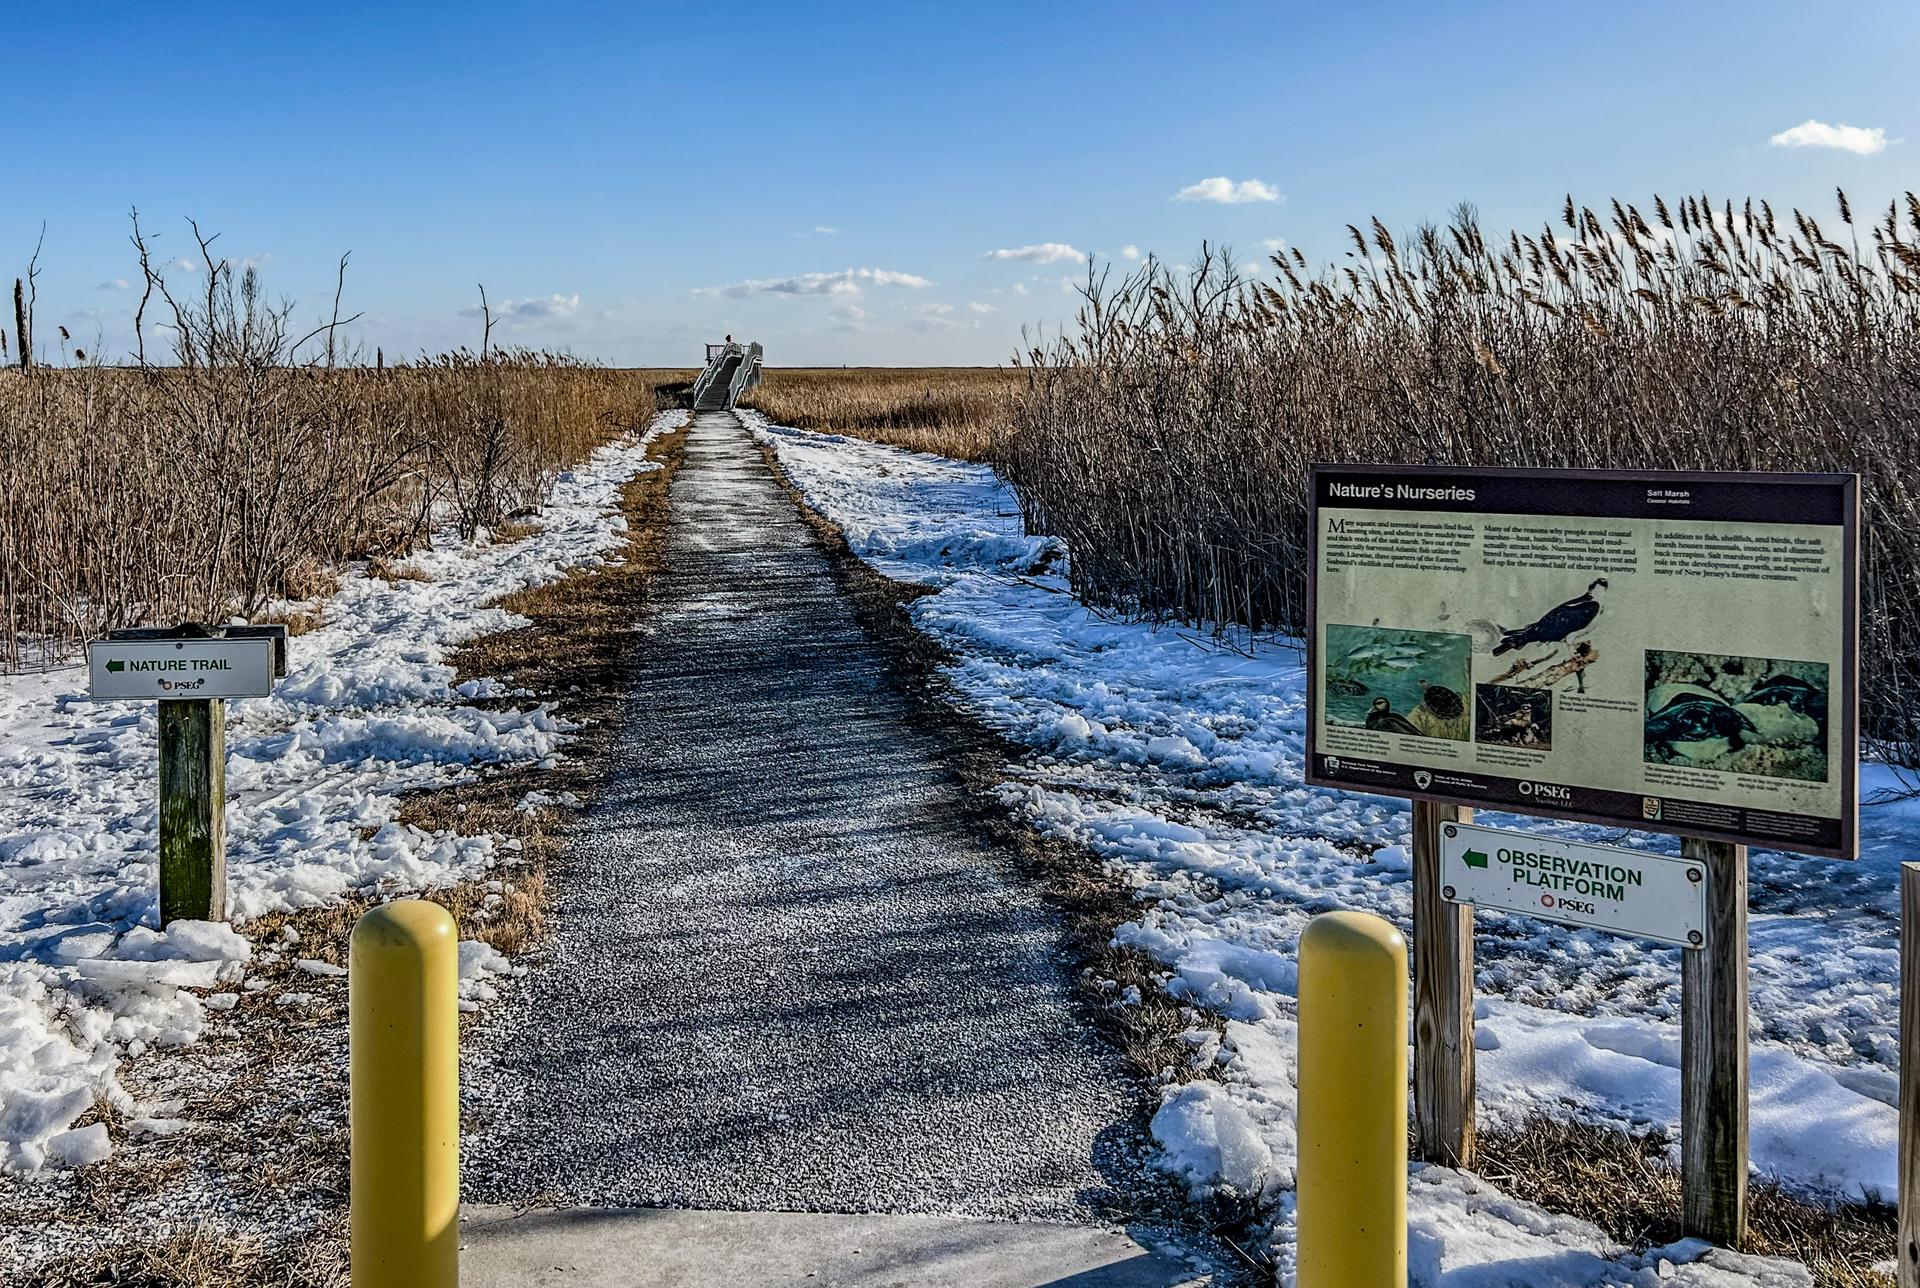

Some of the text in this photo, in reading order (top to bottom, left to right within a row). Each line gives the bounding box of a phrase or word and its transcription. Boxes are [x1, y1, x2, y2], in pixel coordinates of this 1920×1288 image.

[1329, 482, 1476, 500] Nature's Nurseries
[1484, 525, 1501, 533] Many
[1549, 528, 1562, 536] why
[1564, 528, 1586, 537] people
[1533, 535, 1564, 544] humidity,
[1721, 535, 1753, 543] shellfish,
[1770, 537, 1792, 545] birds,
[1483, 542, 1507, 550] actually
[1704, 542, 1741, 551] mammals,
[1743, 544, 1771, 553] insects,
[1788, 546, 1827, 554] diamond-
[1534, 552, 1565, 561] migratory
[1672, 550, 1705, 560] terrapins.
[1754, 554, 1771, 563] play
[1783, 555, 1822, 565] important
[1593, 564, 1609, 572] long
[1691, 560, 1741, 570] development,
[1742, 562, 1771, 572] growth,
[1702, 570, 1730, 579] Jersey's
[130, 659, 232, 671] NATURE TRAIL
[174, 682, 200, 690] PSEG
[1534, 784, 1571, 799] PSEG
[1496, 848, 1642, 886] OBSERVATION
[1513, 868, 1624, 901] PLATFORM
[1558, 898, 1594, 914] PSEG
